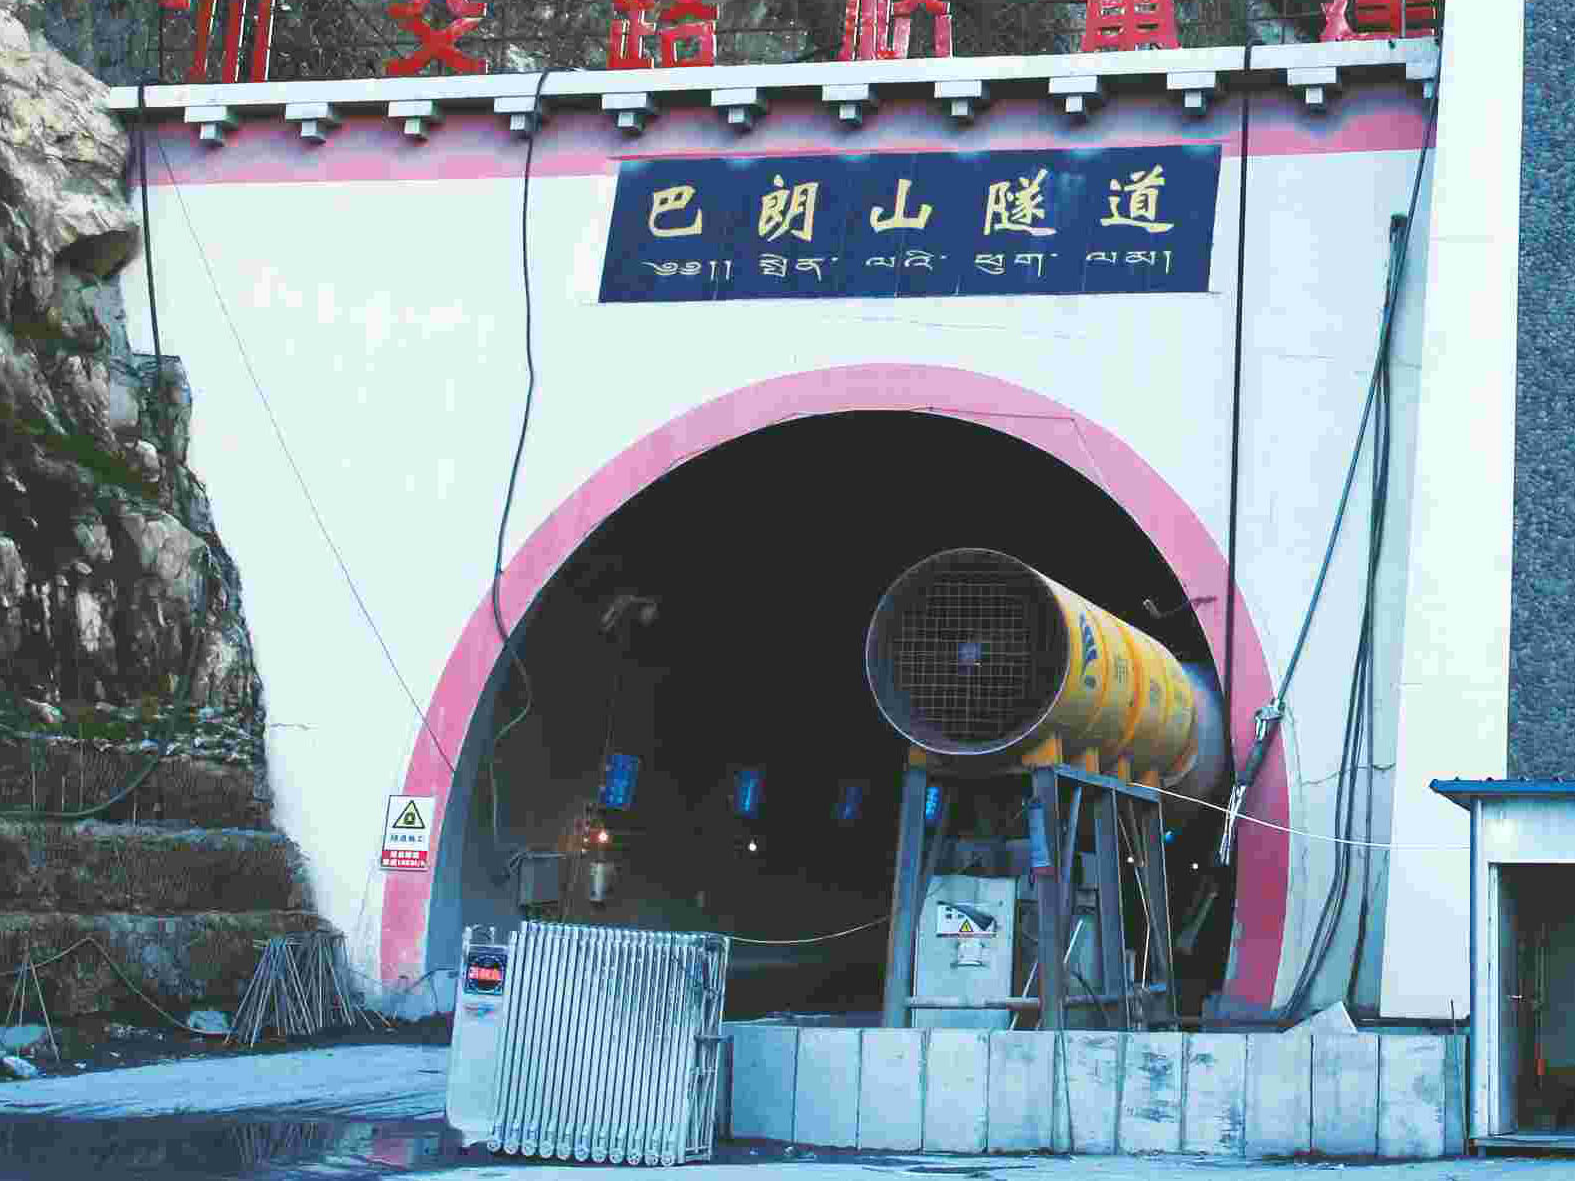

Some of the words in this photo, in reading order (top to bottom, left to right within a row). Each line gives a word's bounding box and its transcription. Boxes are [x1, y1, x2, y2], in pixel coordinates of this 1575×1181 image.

[648, 163, 1175, 244] 巴朗山隧道
